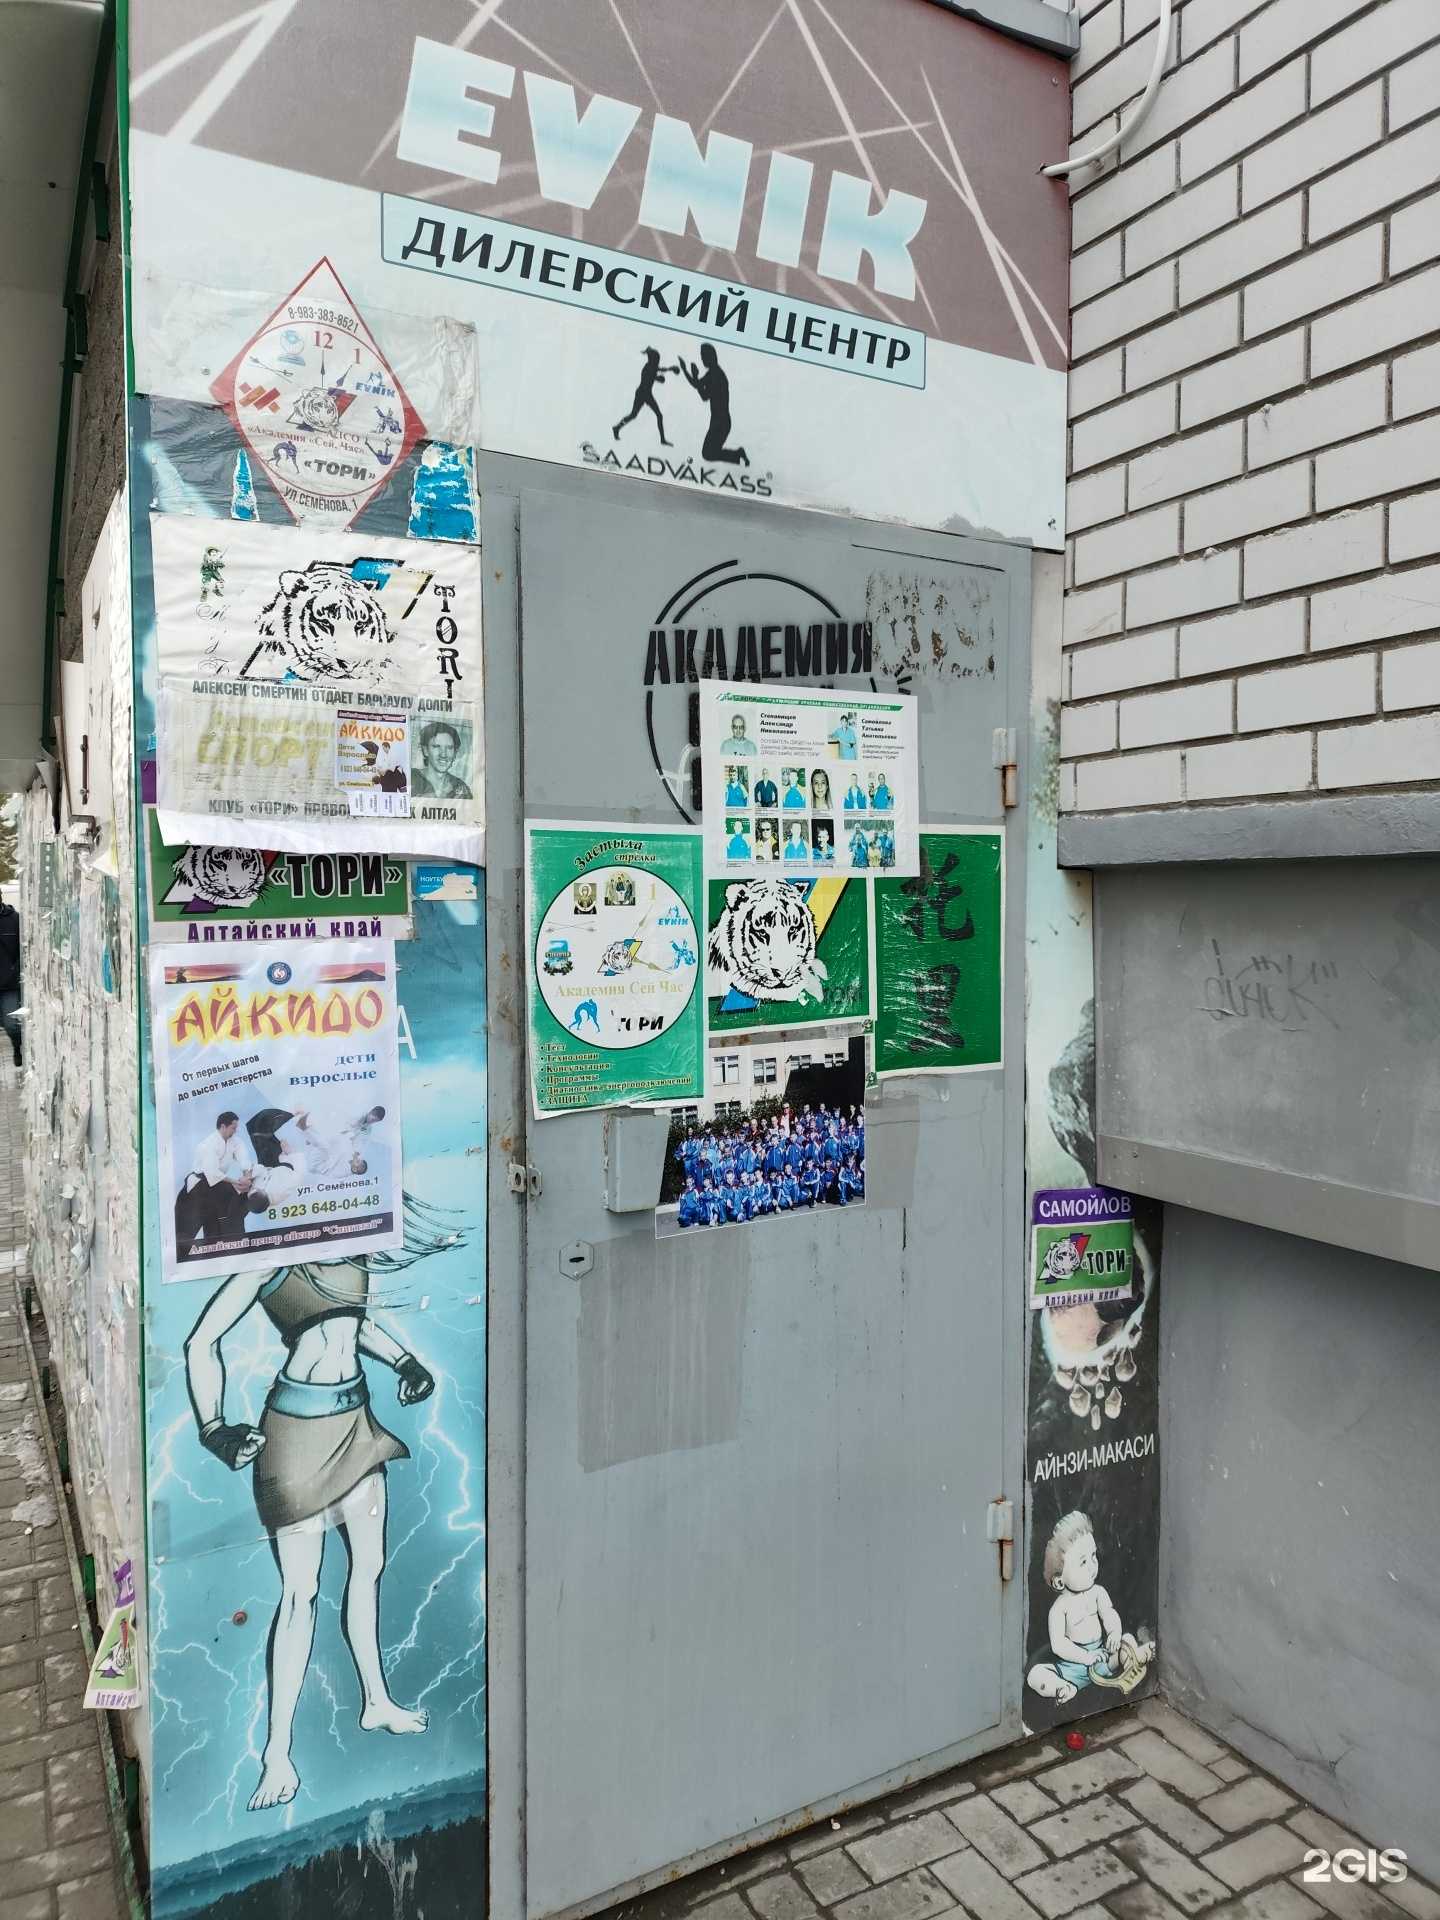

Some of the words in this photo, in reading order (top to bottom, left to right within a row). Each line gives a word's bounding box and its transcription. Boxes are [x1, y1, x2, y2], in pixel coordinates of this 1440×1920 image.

[397, 36, 927, 300] EVNIK
[401, 217, 750, 333] ДИЛЕРСКИЙ
[766, 307, 911, 371] ЦЕНТР
[313, 330, 333, 350] 12
[353, 348, 361, 365] 1
[304, 458, 376, 481] «ТОРИ»
[433, 583, 463, 699] TORI
[643, 621, 873, 686] АКАДЕМИЯ
[252, 684, 307, 701] СМЕРТИН
[417, 698, 453, 713] ДОЛГИ
[339, 720, 406, 742] АЙКИДО
[421, 807, 457, 821] АЛТАЯ
[614, 853, 657, 865] стрелка
[270, 854, 402, 898] «ТОРИ»
[173, 986, 385, 1045] АЙКИДО
[182, 1071, 194, 1082] От
[196, 1063, 231, 1081] первых
[232, 1054, 260, 1070] шагов
[334, 1053, 377, 1066] дети
[178, 1089, 190, 1102] до
[191, 1082, 219, 1097] высот
[221, 1068, 273, 1090] мастерства
[289, 1070, 377, 1087] взрослые
[268, 1208, 278, 1221] 8
[281, 1203, 307, 1218] 923
[312, 1194, 380, 1215] 648-04-48
[1040, 1194, 1131, 1218] САМОЙЛОВ
[1034, 1433, 1155, 1483] АЙНЗИ-МАКАСИ
